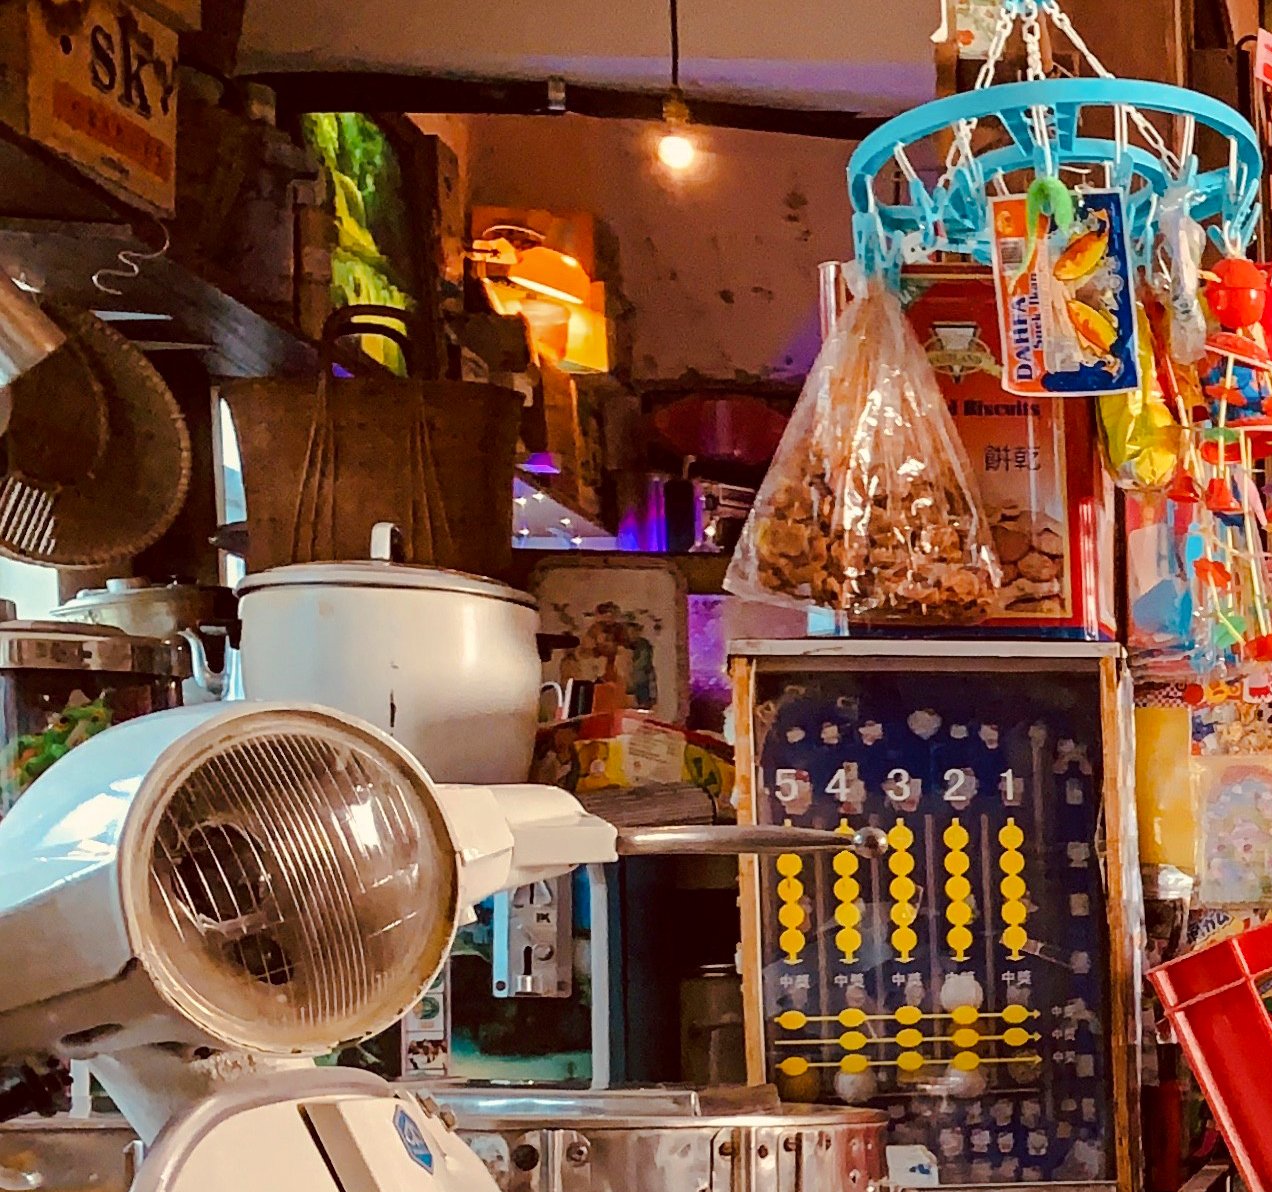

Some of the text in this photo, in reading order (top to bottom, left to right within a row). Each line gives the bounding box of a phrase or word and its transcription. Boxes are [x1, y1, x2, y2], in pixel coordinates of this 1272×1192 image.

[775, 768, 800, 802] 5
[824, 768, 850, 802] 4
[886, 768, 911, 802] 3
[943, 768, 968, 802] 2
[999, 768, 1015, 801] 1
